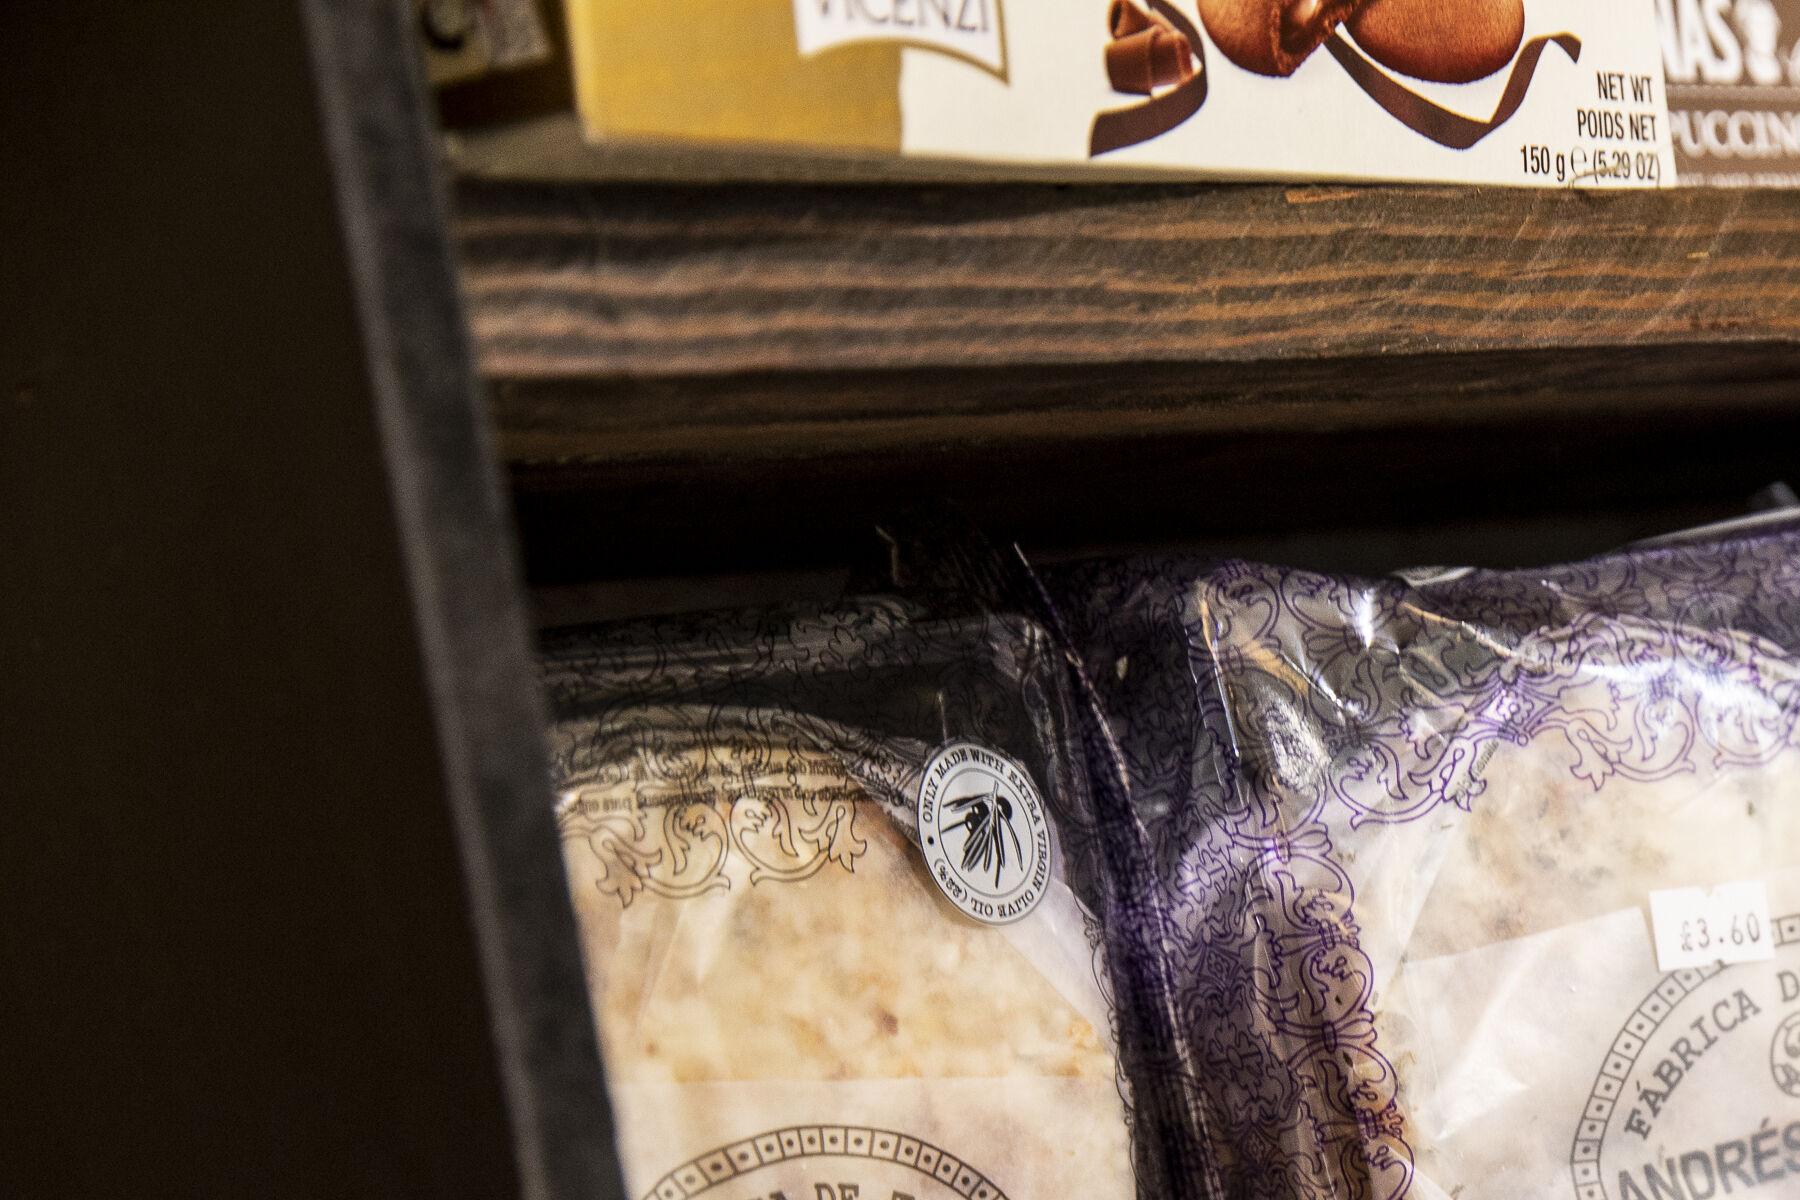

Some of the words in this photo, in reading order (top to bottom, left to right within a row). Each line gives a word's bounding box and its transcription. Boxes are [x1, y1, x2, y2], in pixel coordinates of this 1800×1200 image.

[1597, 72, 1625, 101] NET
[1630, 75, 1653, 103] WT
[1577, 109, 1625, 140] POIDS
[1629, 113, 1657, 142] NET
[1521, 144, 1551, 175] 150
[1556, 153, 1565, 182] g
[1593, 149, 1631, 185] (5.29
[1636, 152, 1661, 188] OZ)
[936, 748, 969, 780] MADE
[970, 748, 1006, 775] WITH
[923, 779, 939, 824] ONLY
[1008, 771, 1042, 826] EXTRA
[1032, 829, 1047, 892] VIRGIN
[970, 897, 994, 917] OIL
[997, 889, 1035, 919] OLIVE
[1679, 912, 1762, 952] £3.60
[1624, 988, 1762, 1141] FÁBRICA
